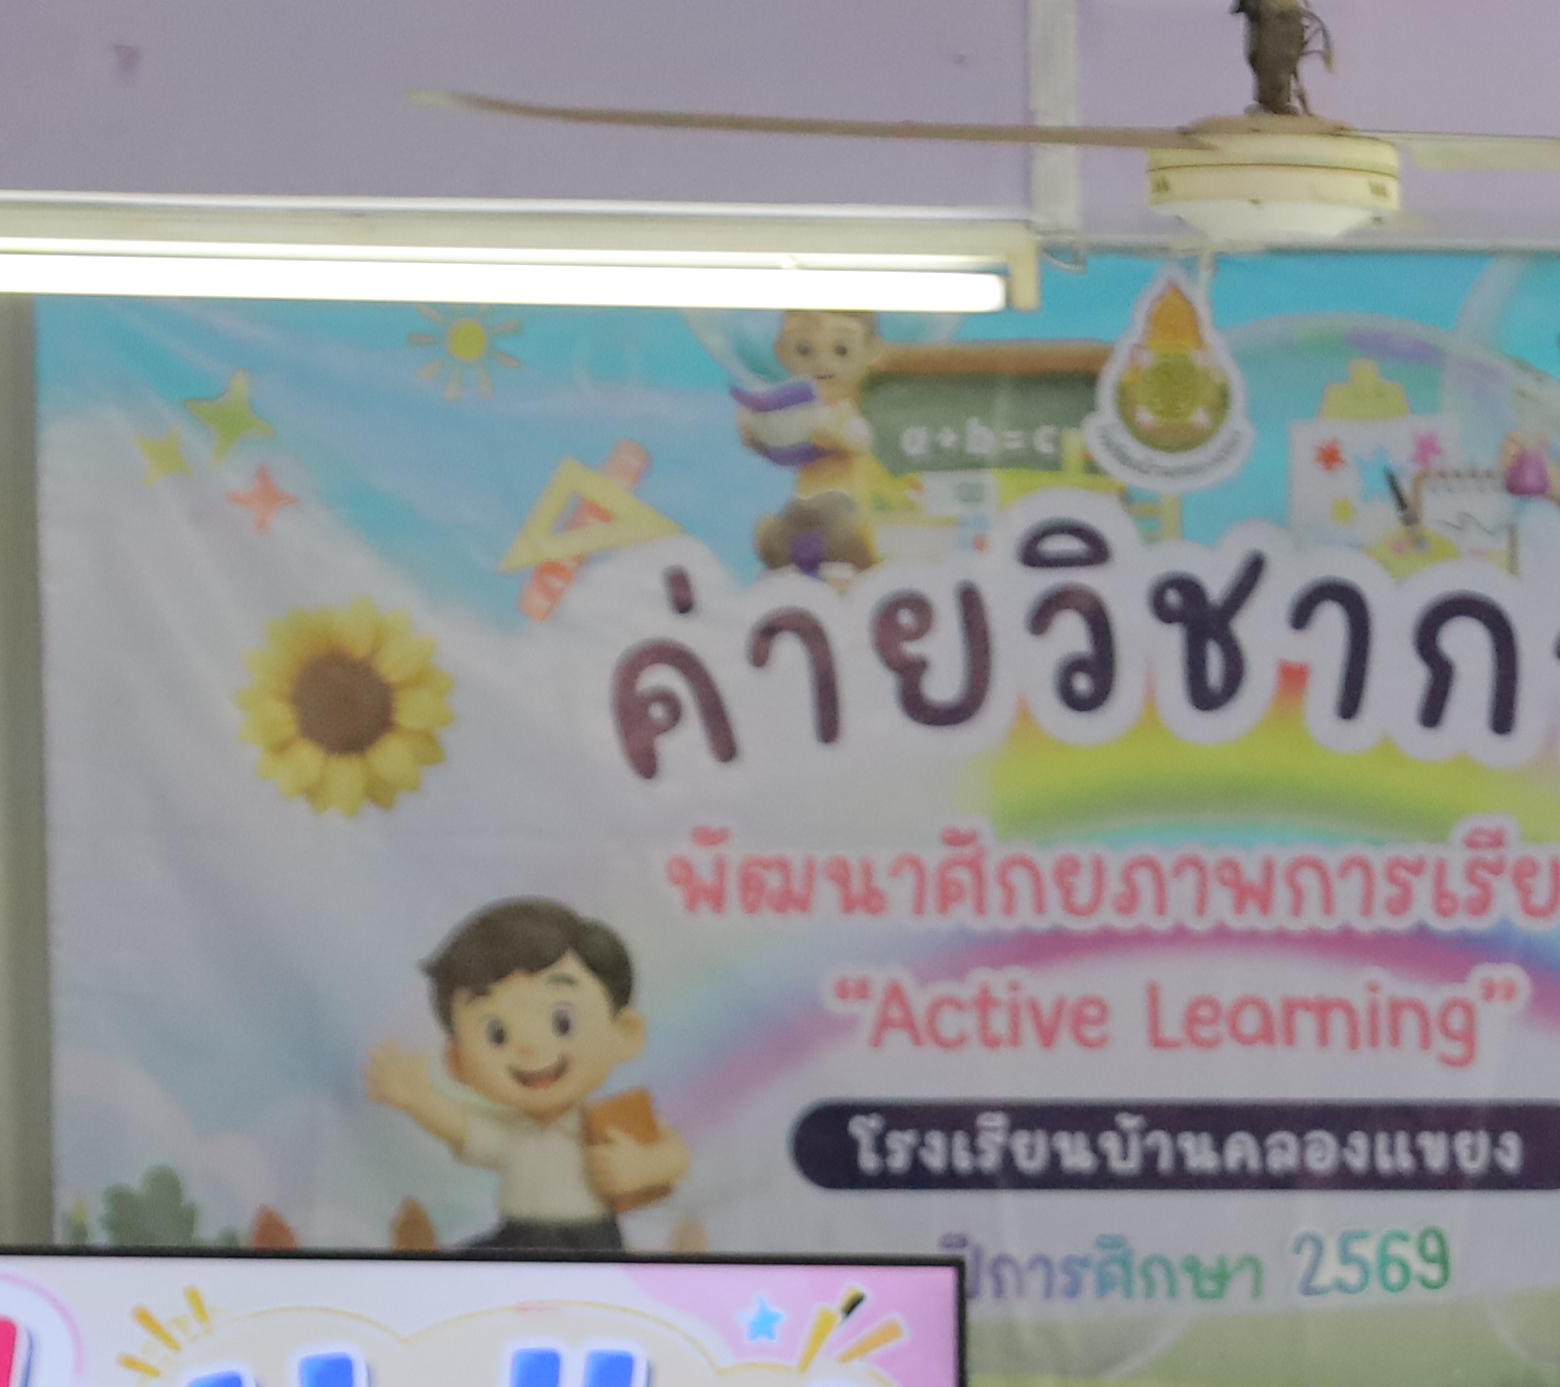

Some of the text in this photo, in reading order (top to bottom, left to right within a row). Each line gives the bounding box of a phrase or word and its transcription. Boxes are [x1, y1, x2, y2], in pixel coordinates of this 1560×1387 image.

[846, 1111, 1526, 1177] โรงเรียนบ้านคลองแขยง
[1292, 1224, 1454, 1298] 2569
